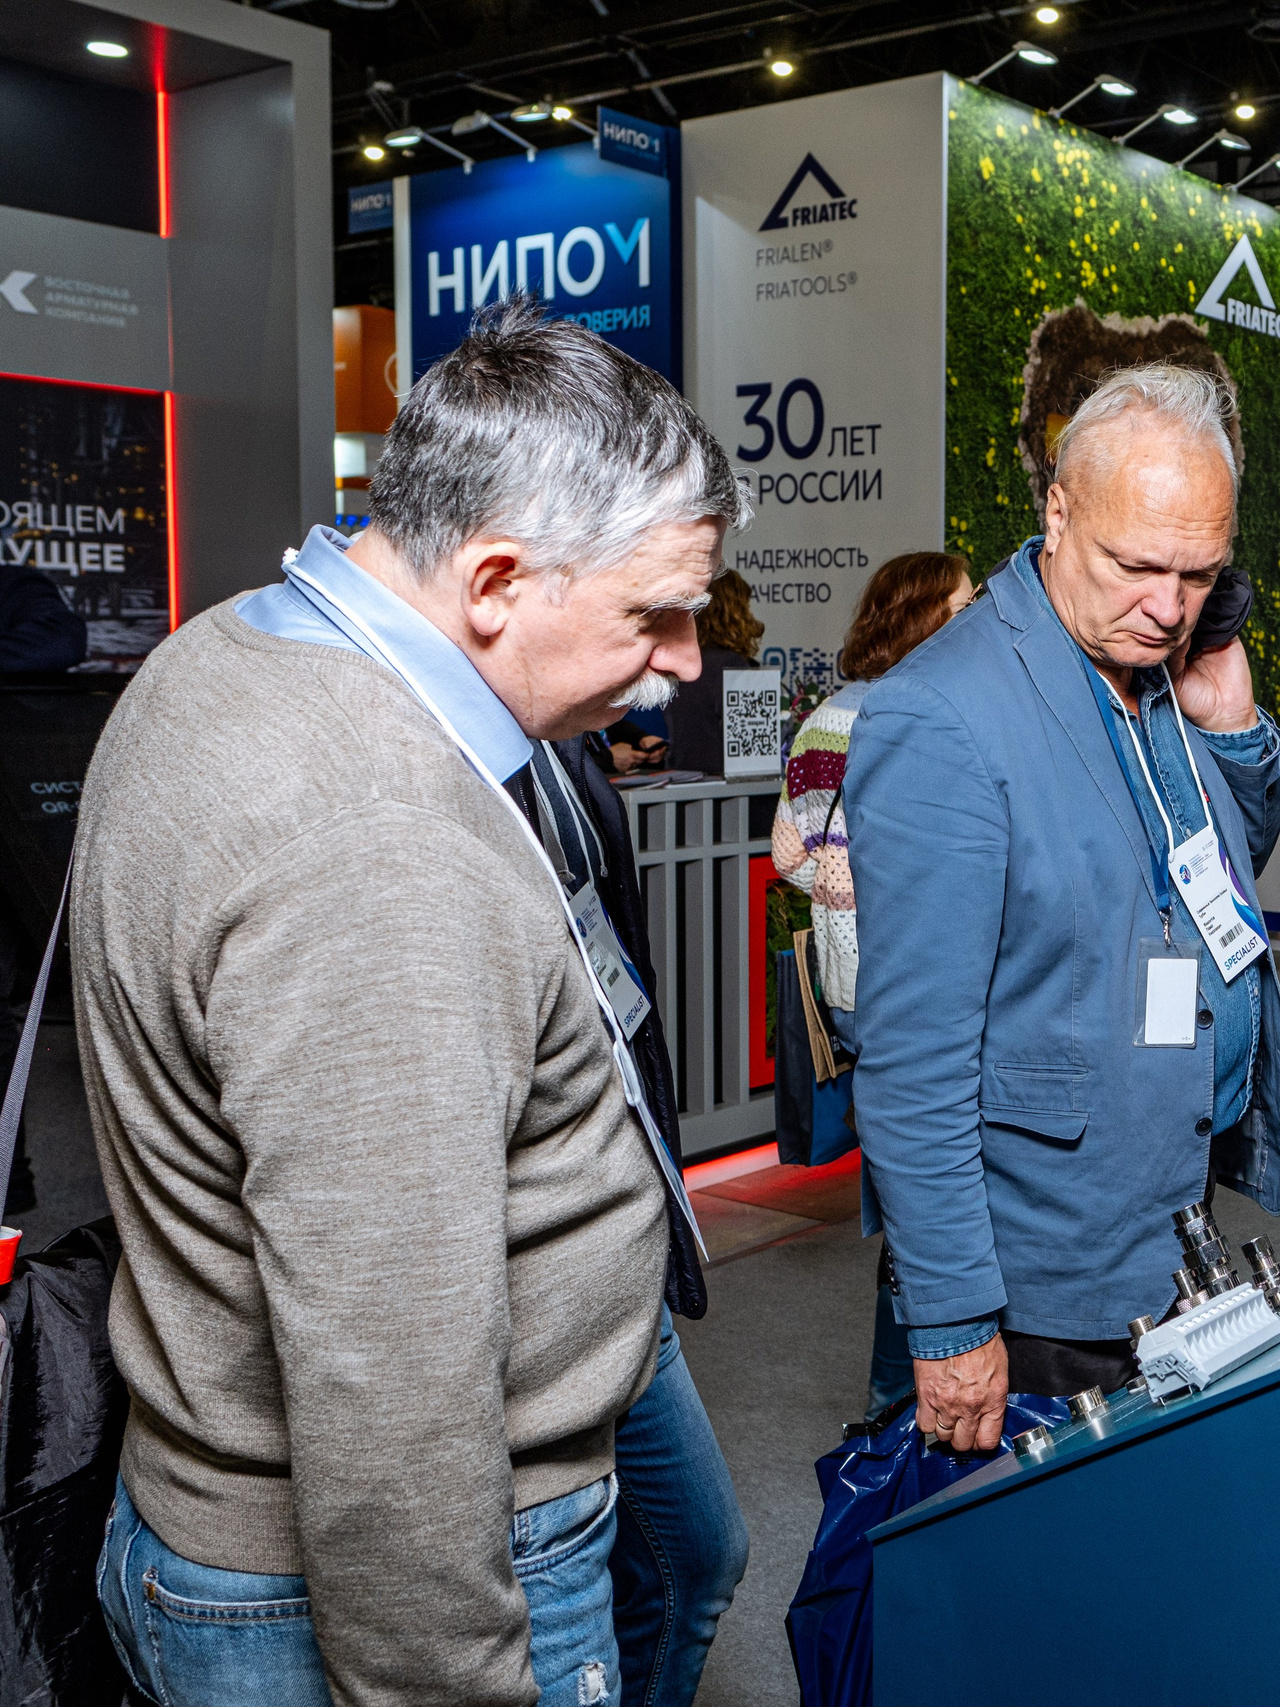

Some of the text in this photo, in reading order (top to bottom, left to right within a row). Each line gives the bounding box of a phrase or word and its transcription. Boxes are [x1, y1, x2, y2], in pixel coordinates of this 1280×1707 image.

[791, 198, 858, 227] FRIATEC
[564, 305, 650, 333] ОВЕРИЯ
[736, 377, 882, 463] 30 ЛЕТ
[759, 468, 882, 505] РОССИИ
[0, 538, 126, 577] УЩЕЕ
[736, 547, 869, 572] НАДЕЖНОСТЬ
[750, 582, 831, 603] АЧЕСТВО
[1224, 936, 1260, 970] SPECIALIST
[623, 995, 645, 1028] SPECIALIST
